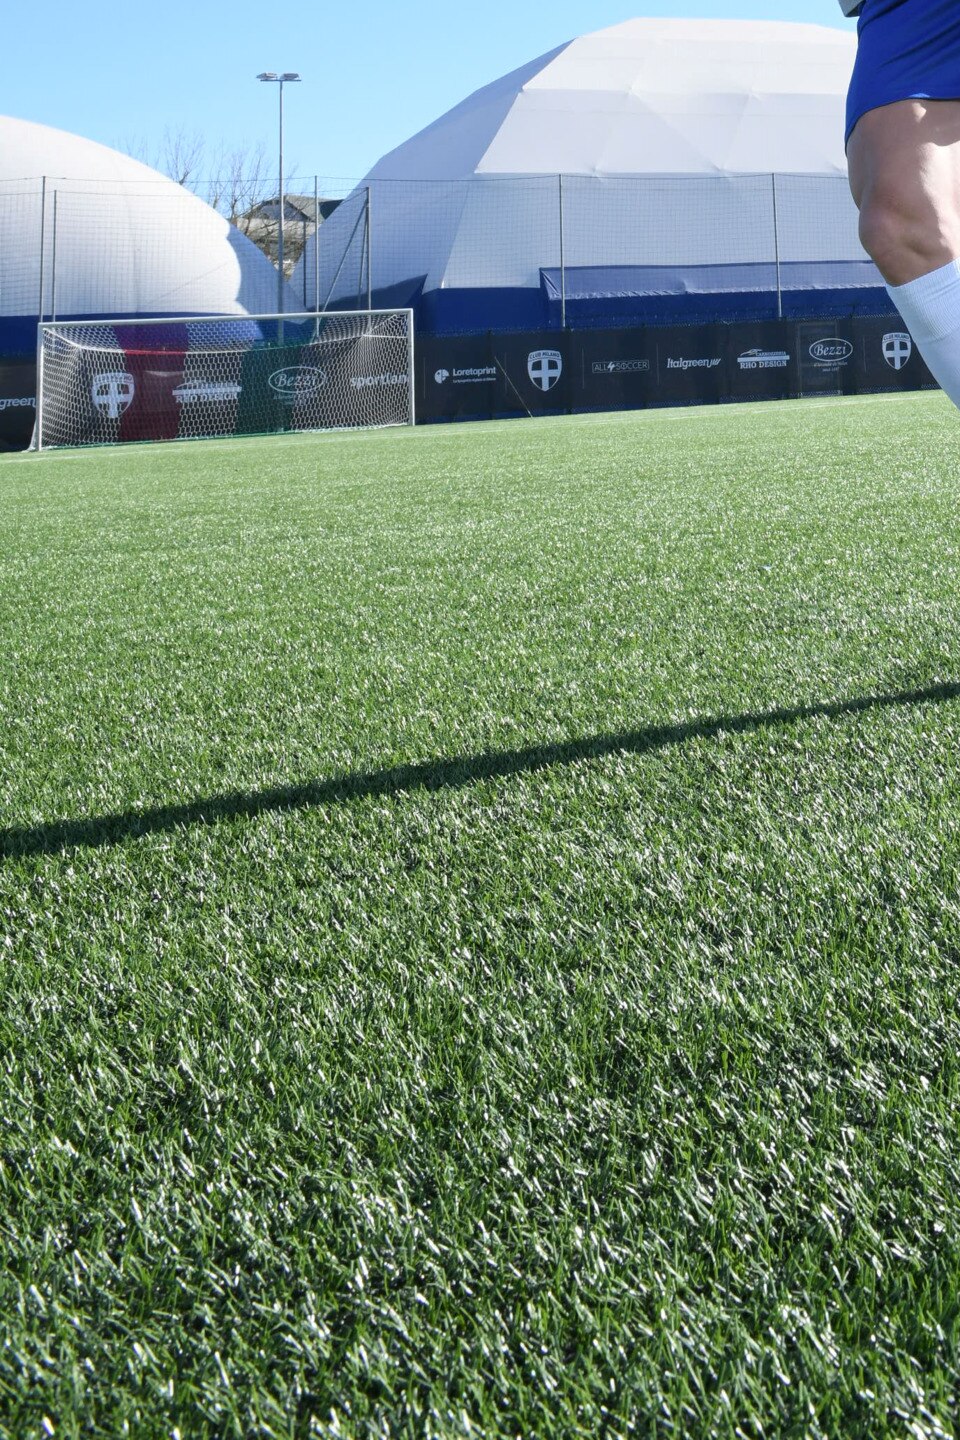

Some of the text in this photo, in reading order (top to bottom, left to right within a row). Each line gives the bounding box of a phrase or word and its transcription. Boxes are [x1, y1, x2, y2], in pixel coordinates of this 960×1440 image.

[813, 342, 847, 356] Bezzi
[666, 357, 713, 370] Italgreen
[740, 360, 787, 369] RHO DESIGN
[452, 366, 497, 377] Loretoprint
[350, 372, 408, 389] sportlan
